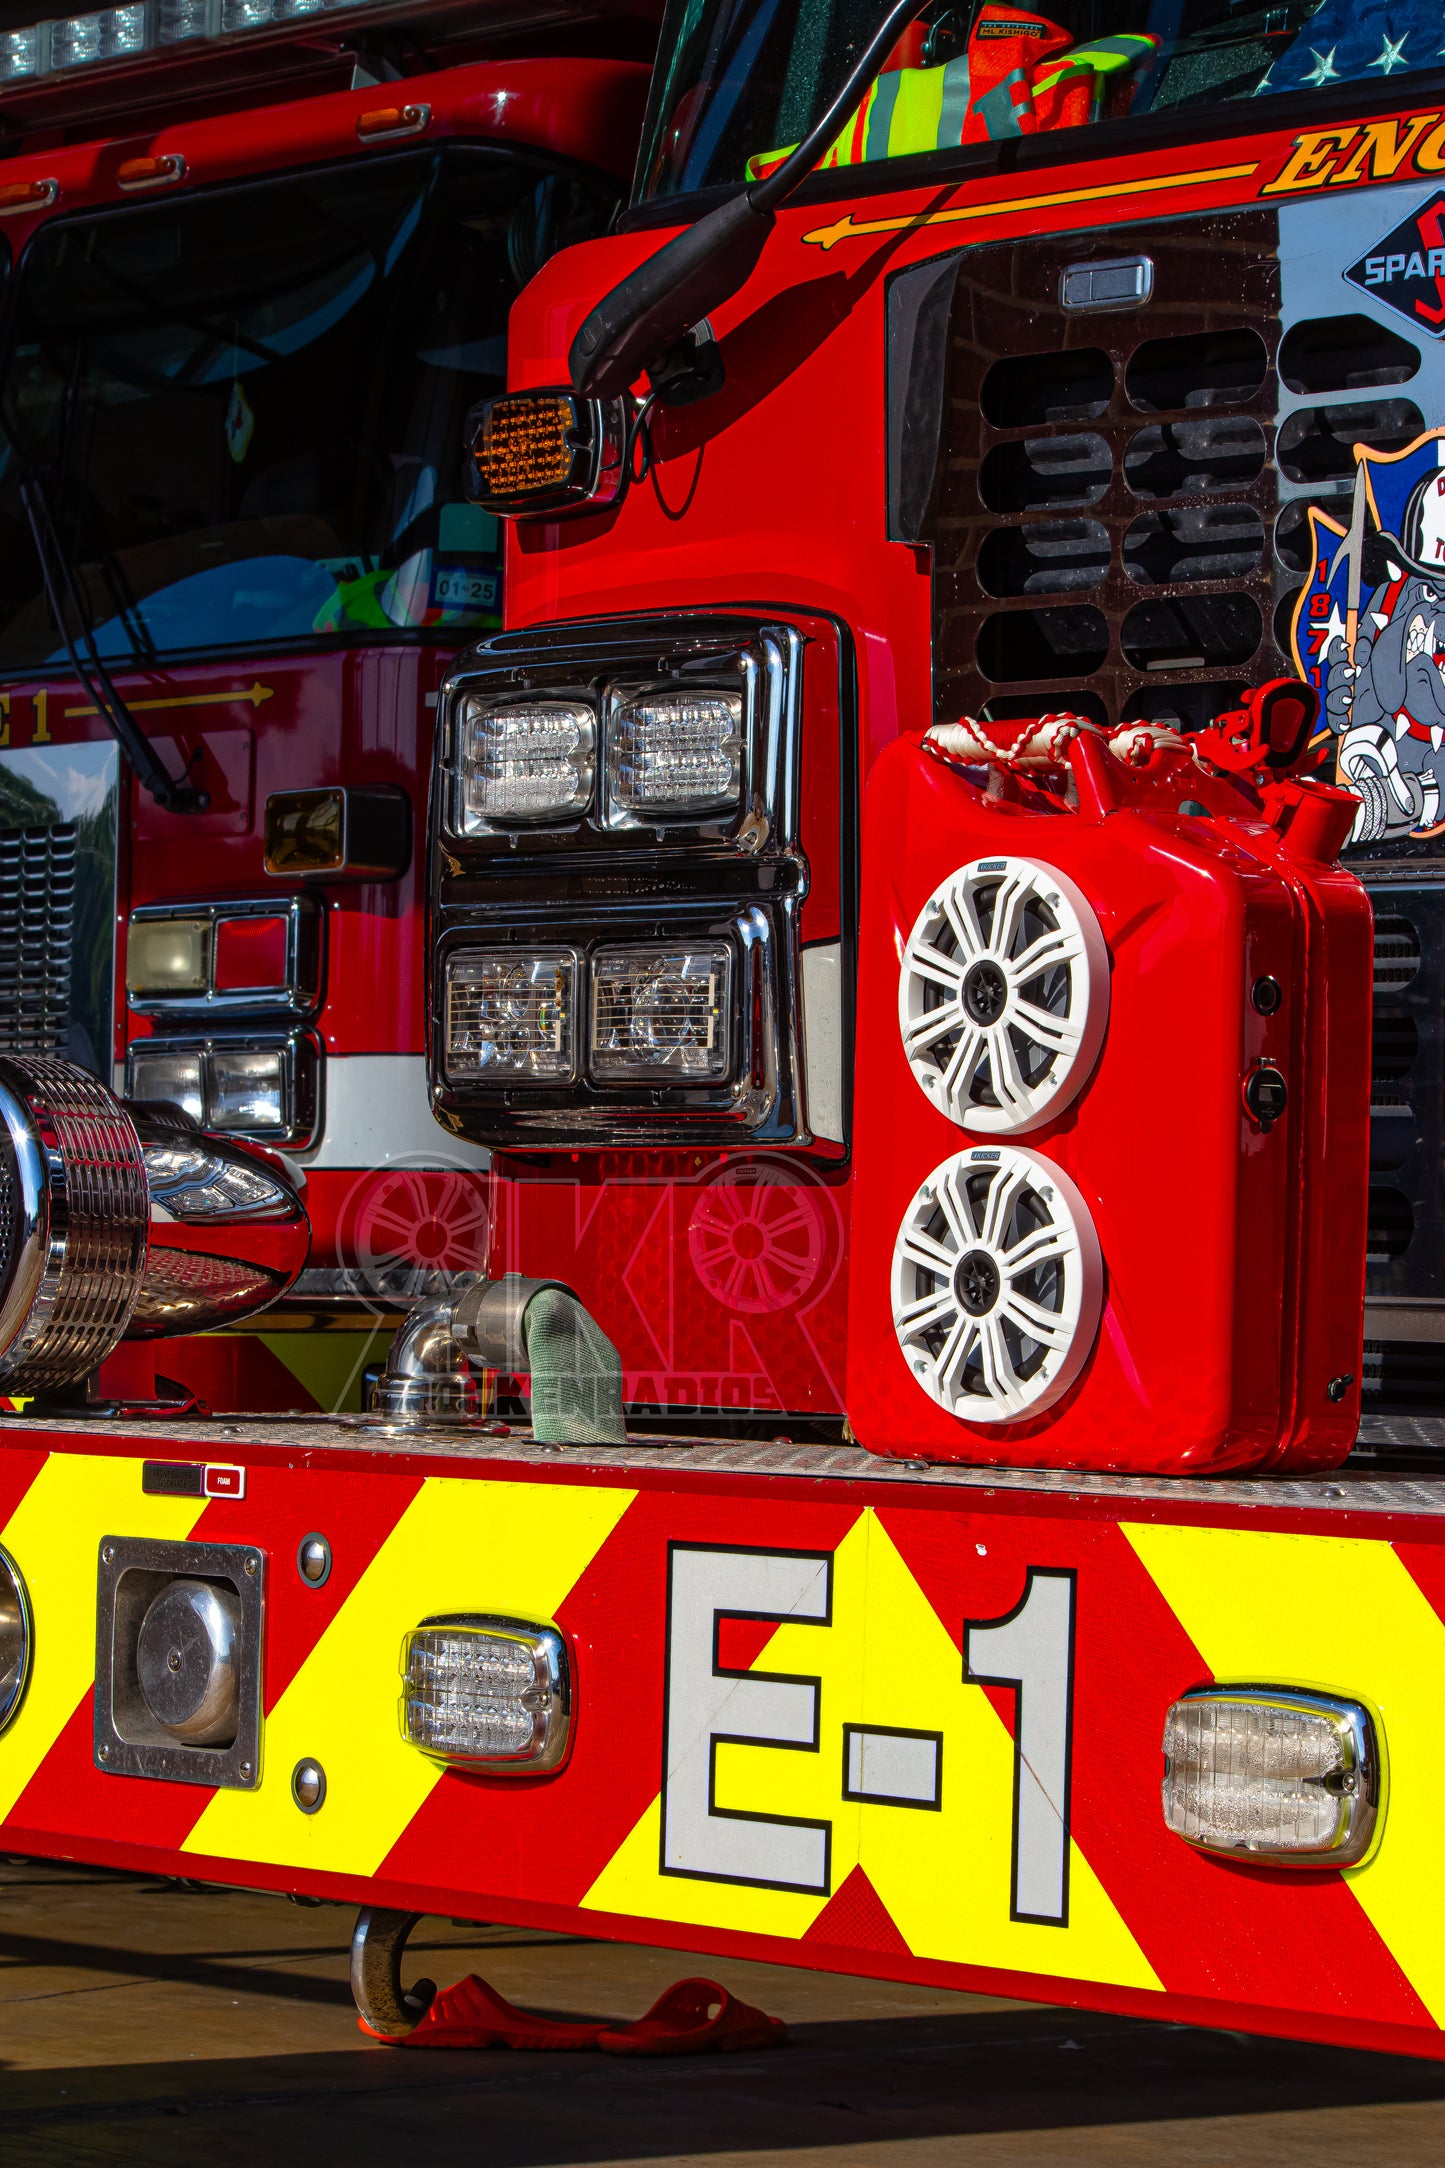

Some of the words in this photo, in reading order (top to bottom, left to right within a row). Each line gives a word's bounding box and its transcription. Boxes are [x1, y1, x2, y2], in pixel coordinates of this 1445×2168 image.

[32, 688, 51, 743] 1
[972, 1151, 1000, 1160] KICKER
[217, 1477, 231, 1485] FOAM
[658, 1540, 1078, 1928] E-1
